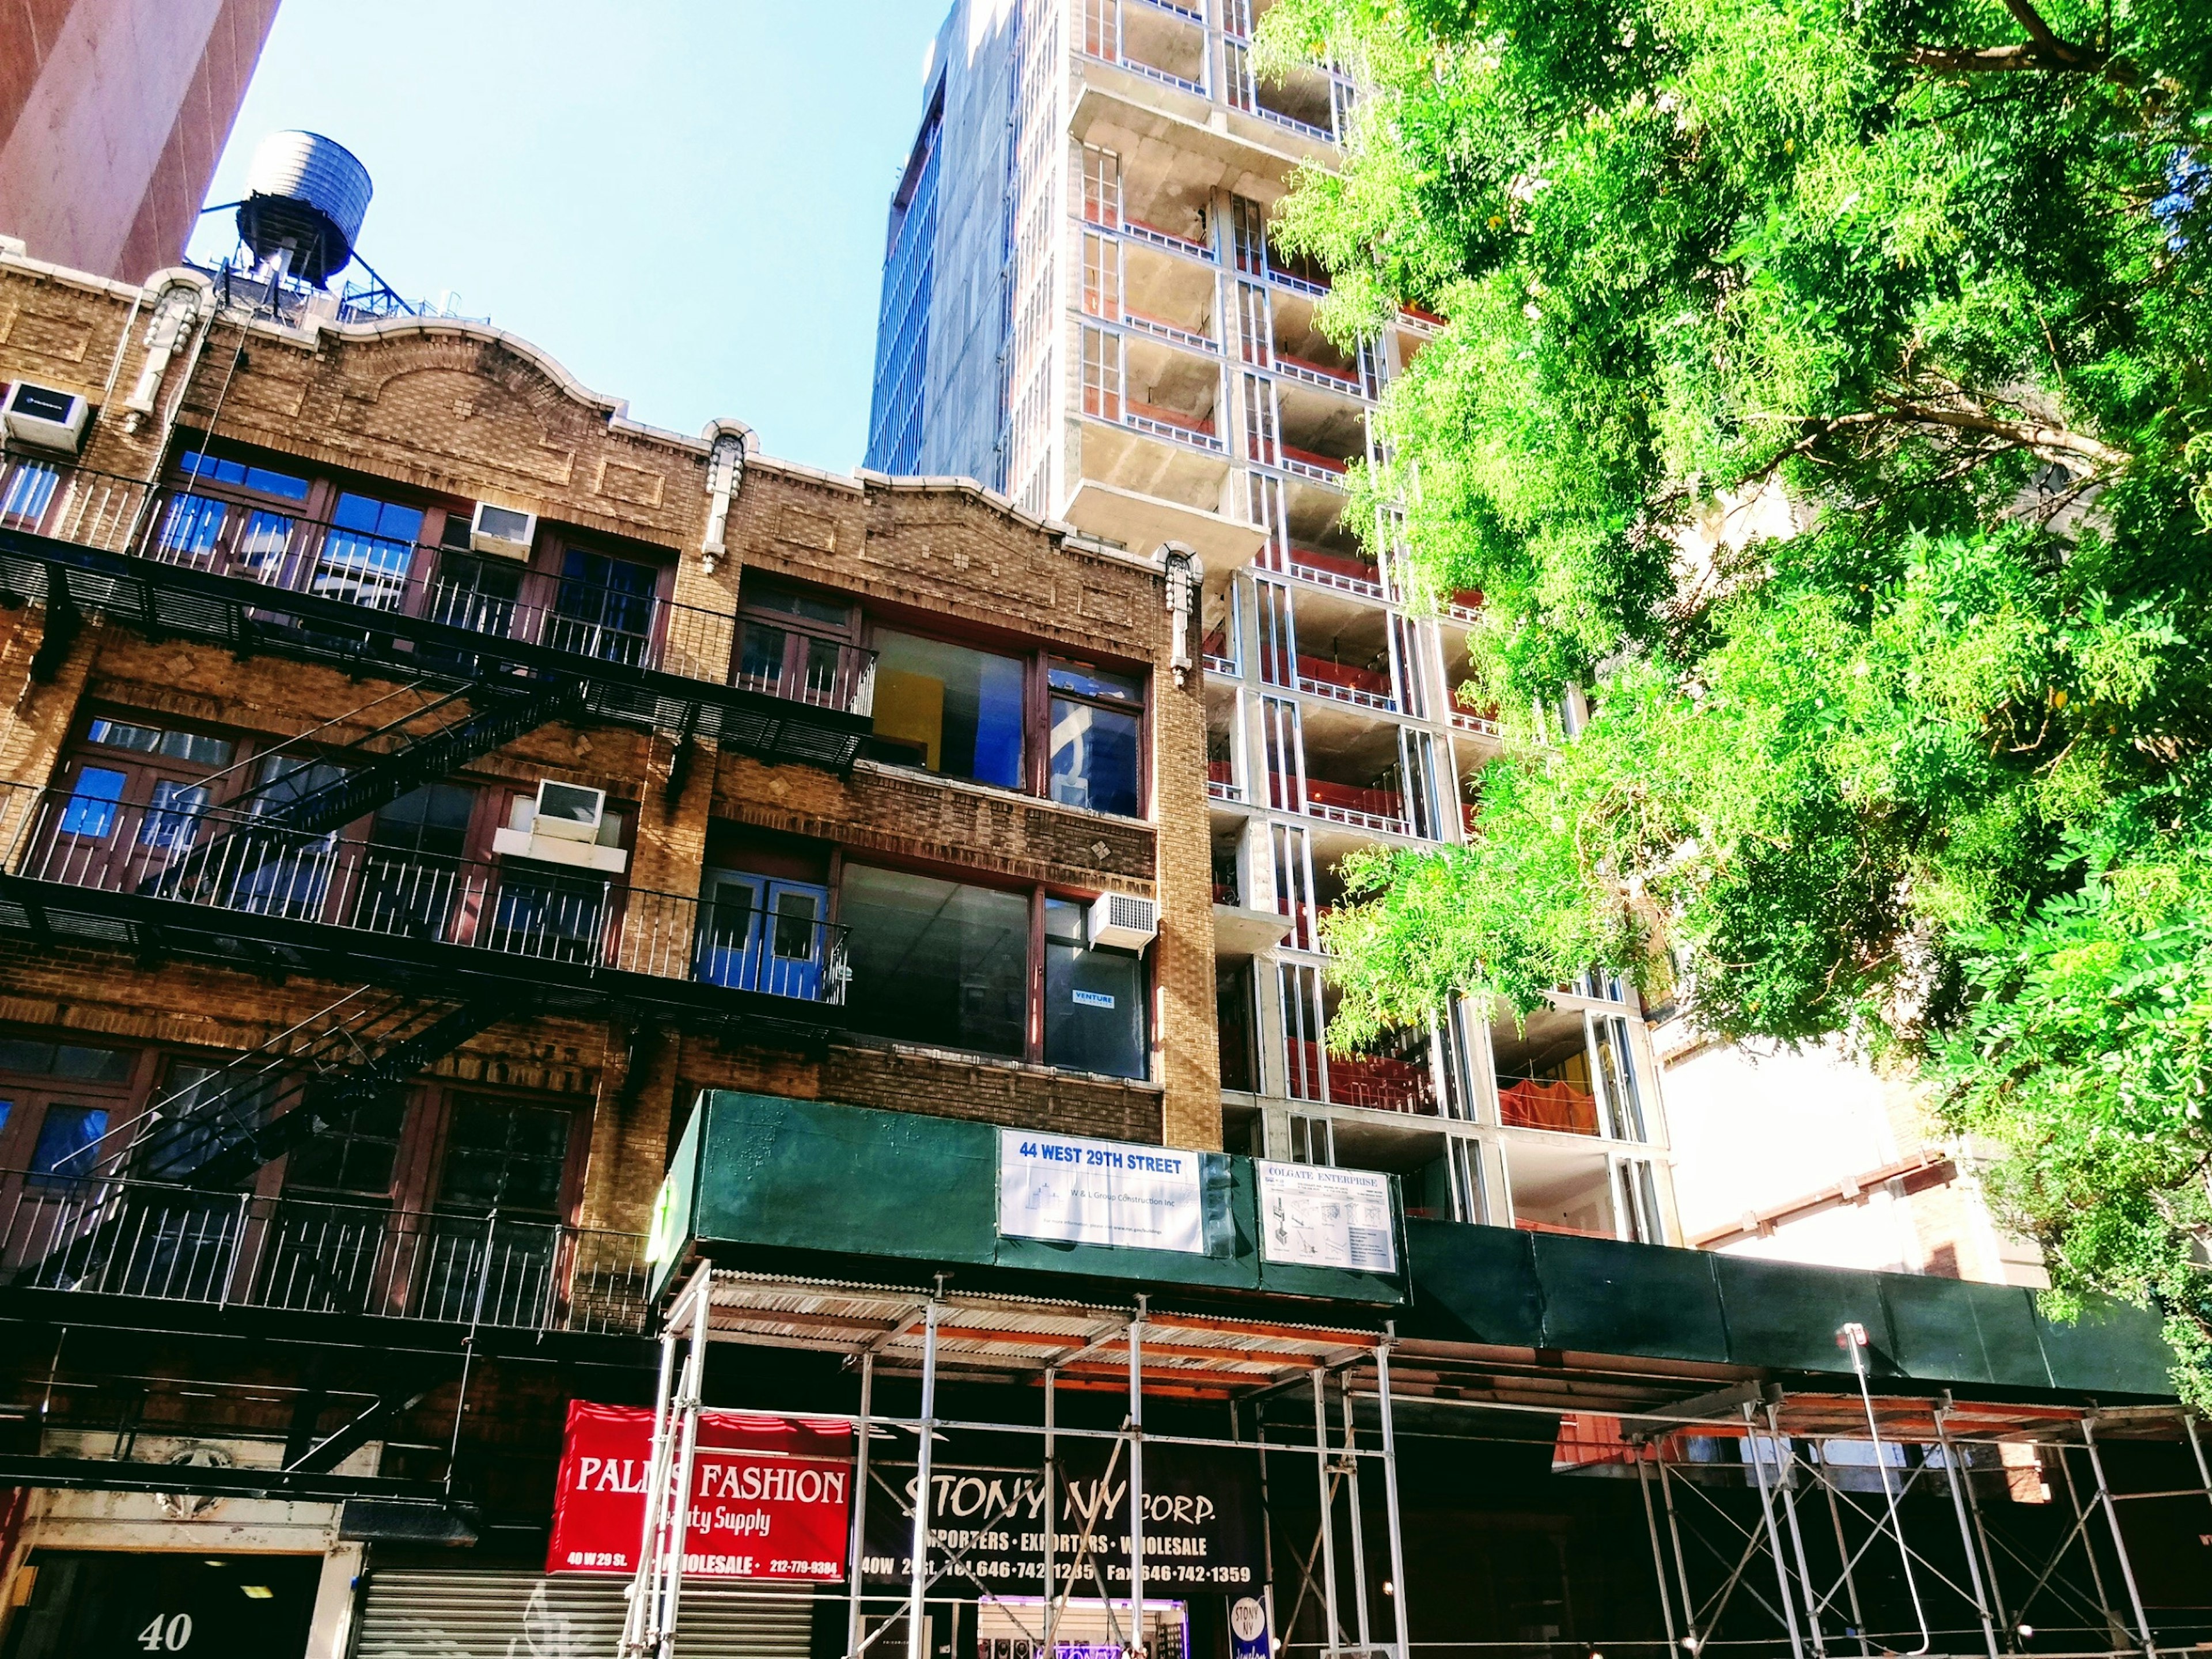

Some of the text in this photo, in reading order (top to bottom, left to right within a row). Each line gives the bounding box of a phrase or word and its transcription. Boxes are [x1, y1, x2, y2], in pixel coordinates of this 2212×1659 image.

[1076, 992, 1112, 1003] VENTURE
[1020, 1142, 1181, 1174] 44 WEST 29TH STREET
[1269, 1167, 1313, 1180] COLGATE
[1318, 1173, 1377, 1187] ENTERPRISE
[1094, 1192, 1116, 1201] Group
[1118, 1194, 1163, 1206] Construction
[1165, 1199, 1175, 1207] Inc
[699, 1464, 846, 1503] FASHION
[902, 1475, 1046, 1519] STONY
[1063, 1479, 1126, 1520] NY
[714, 1506, 771, 1537] Supply
[927, 1529, 1009, 1551] MPORTERS
[1021, 1533, 1108, 1554] EXPORTRS
[567, 1551, 583, 1565] 40
[584, 1552, 597, 1566] W
[596, 1552, 612, 1566] 29
[770, 1559, 838, 1575] 212-779-9384
[862, 1556, 895, 1575] 40W
[1236, 1605, 1258, 1622] STONY
[138, 1613, 192, 1651] 40
[1243, 1622, 1253, 1635] NY
